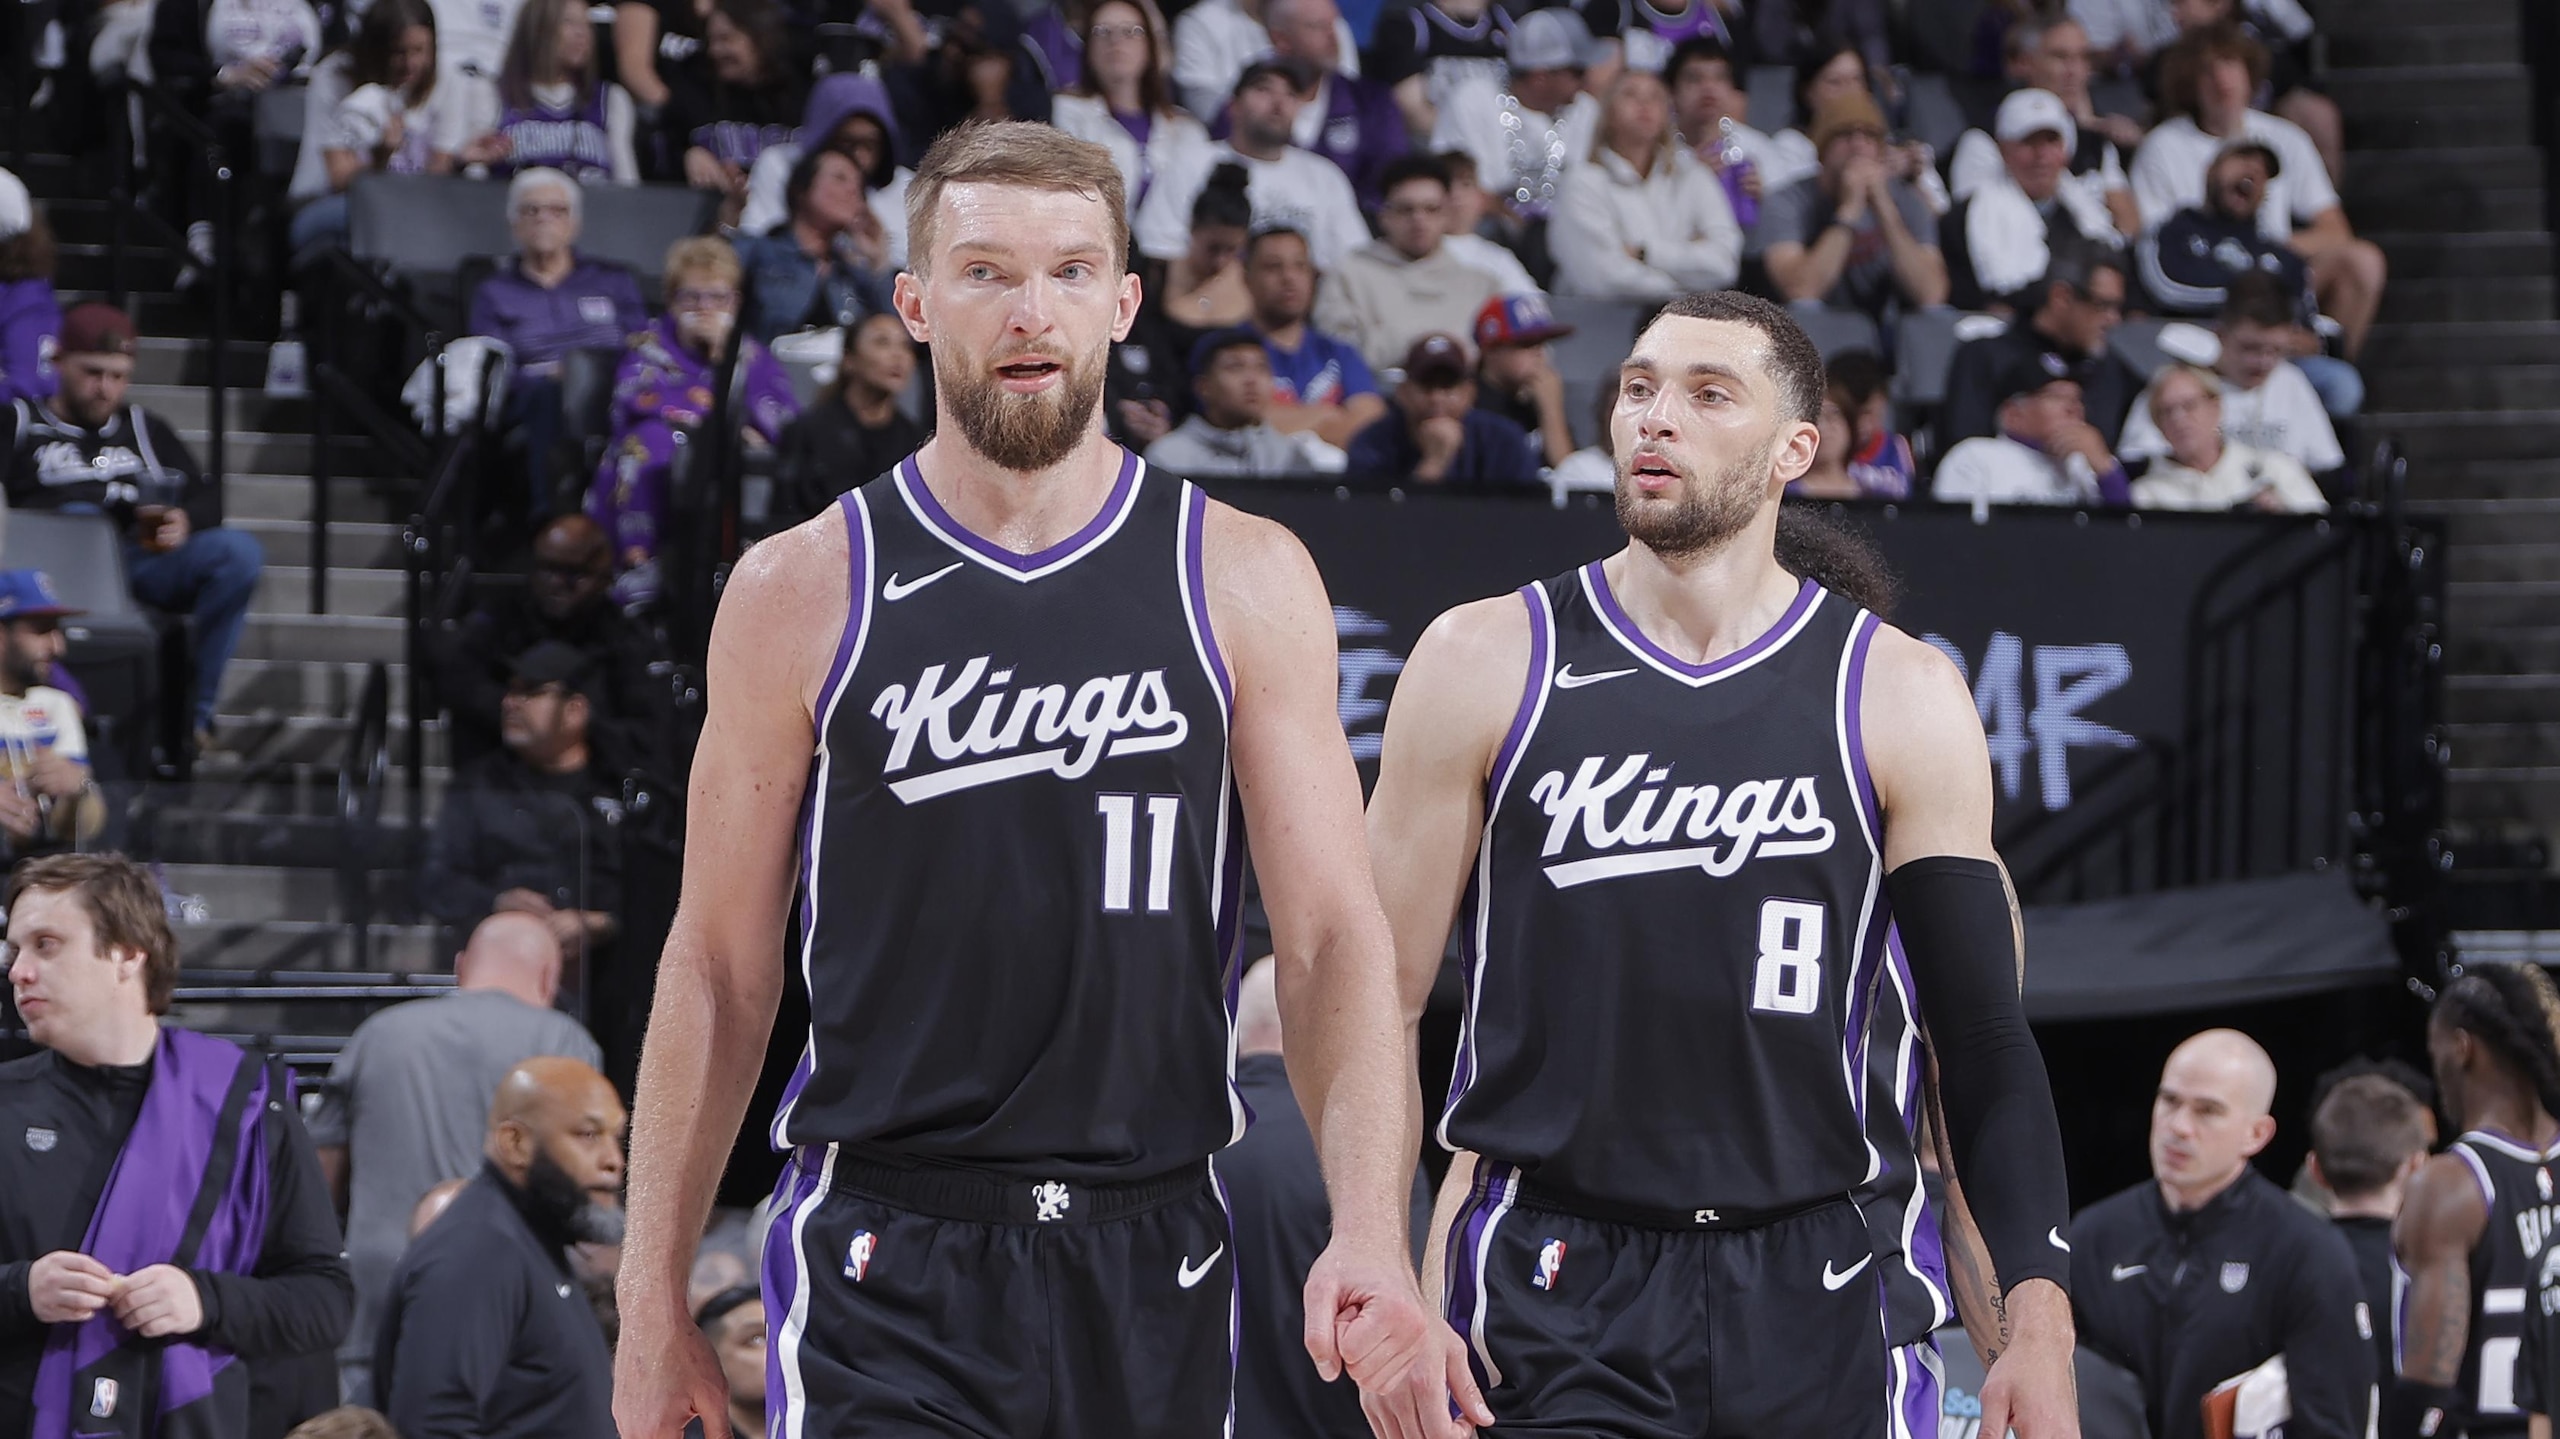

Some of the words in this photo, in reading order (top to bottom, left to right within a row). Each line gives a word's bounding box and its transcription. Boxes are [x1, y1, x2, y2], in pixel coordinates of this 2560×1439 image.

[870, 655, 1188, 805] Kings
[1919, 629, 2142, 811] AR
[1097, 793, 1181, 913] 11
[1529, 753, 1836, 889] Kings
[1752, 898, 1825, 1013] 8
